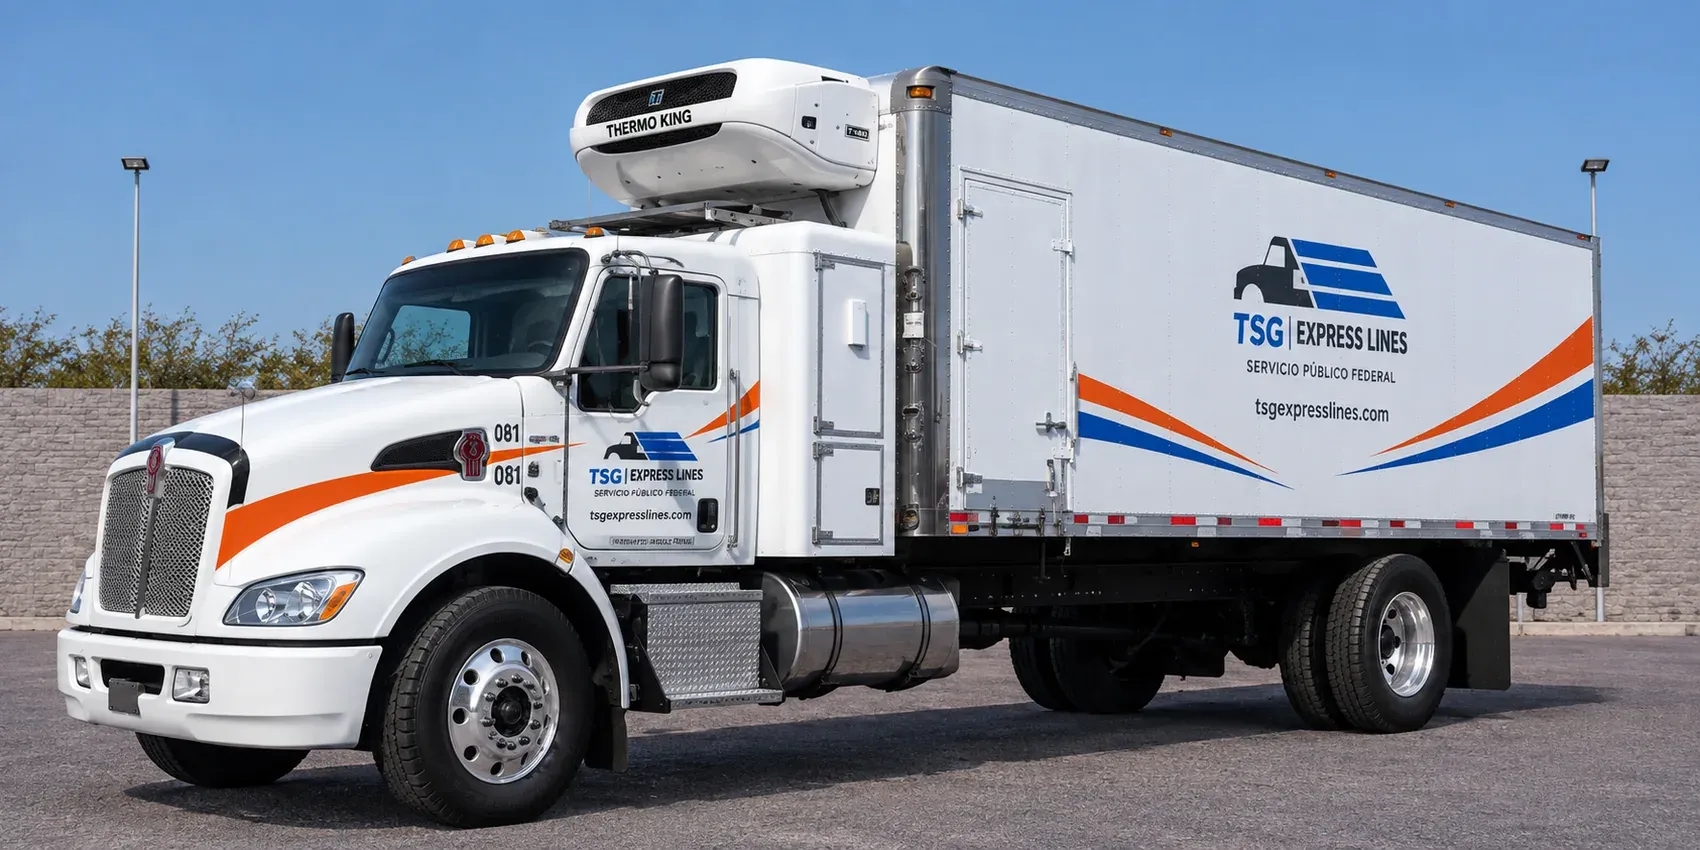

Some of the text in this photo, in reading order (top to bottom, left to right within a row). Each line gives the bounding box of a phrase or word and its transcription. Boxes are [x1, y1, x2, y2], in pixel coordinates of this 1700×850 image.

[606, 109, 692, 138] THERMO KING
[1233, 312, 1408, 355] TSG EXPRESS LINES
[1246, 359, 1396, 384] SERVICIO PÚBLICO FEDERAL
[1254, 398, 1389, 423] tsgexpresslines.com
[494, 423, 519, 443] 081
[494, 465, 521, 486] 081
[588, 468, 704, 485] TSG EXPRESS LINES
[593, 489, 629, 498] SERVICIO
[589, 509, 692, 523] tsgexpresslines.com
